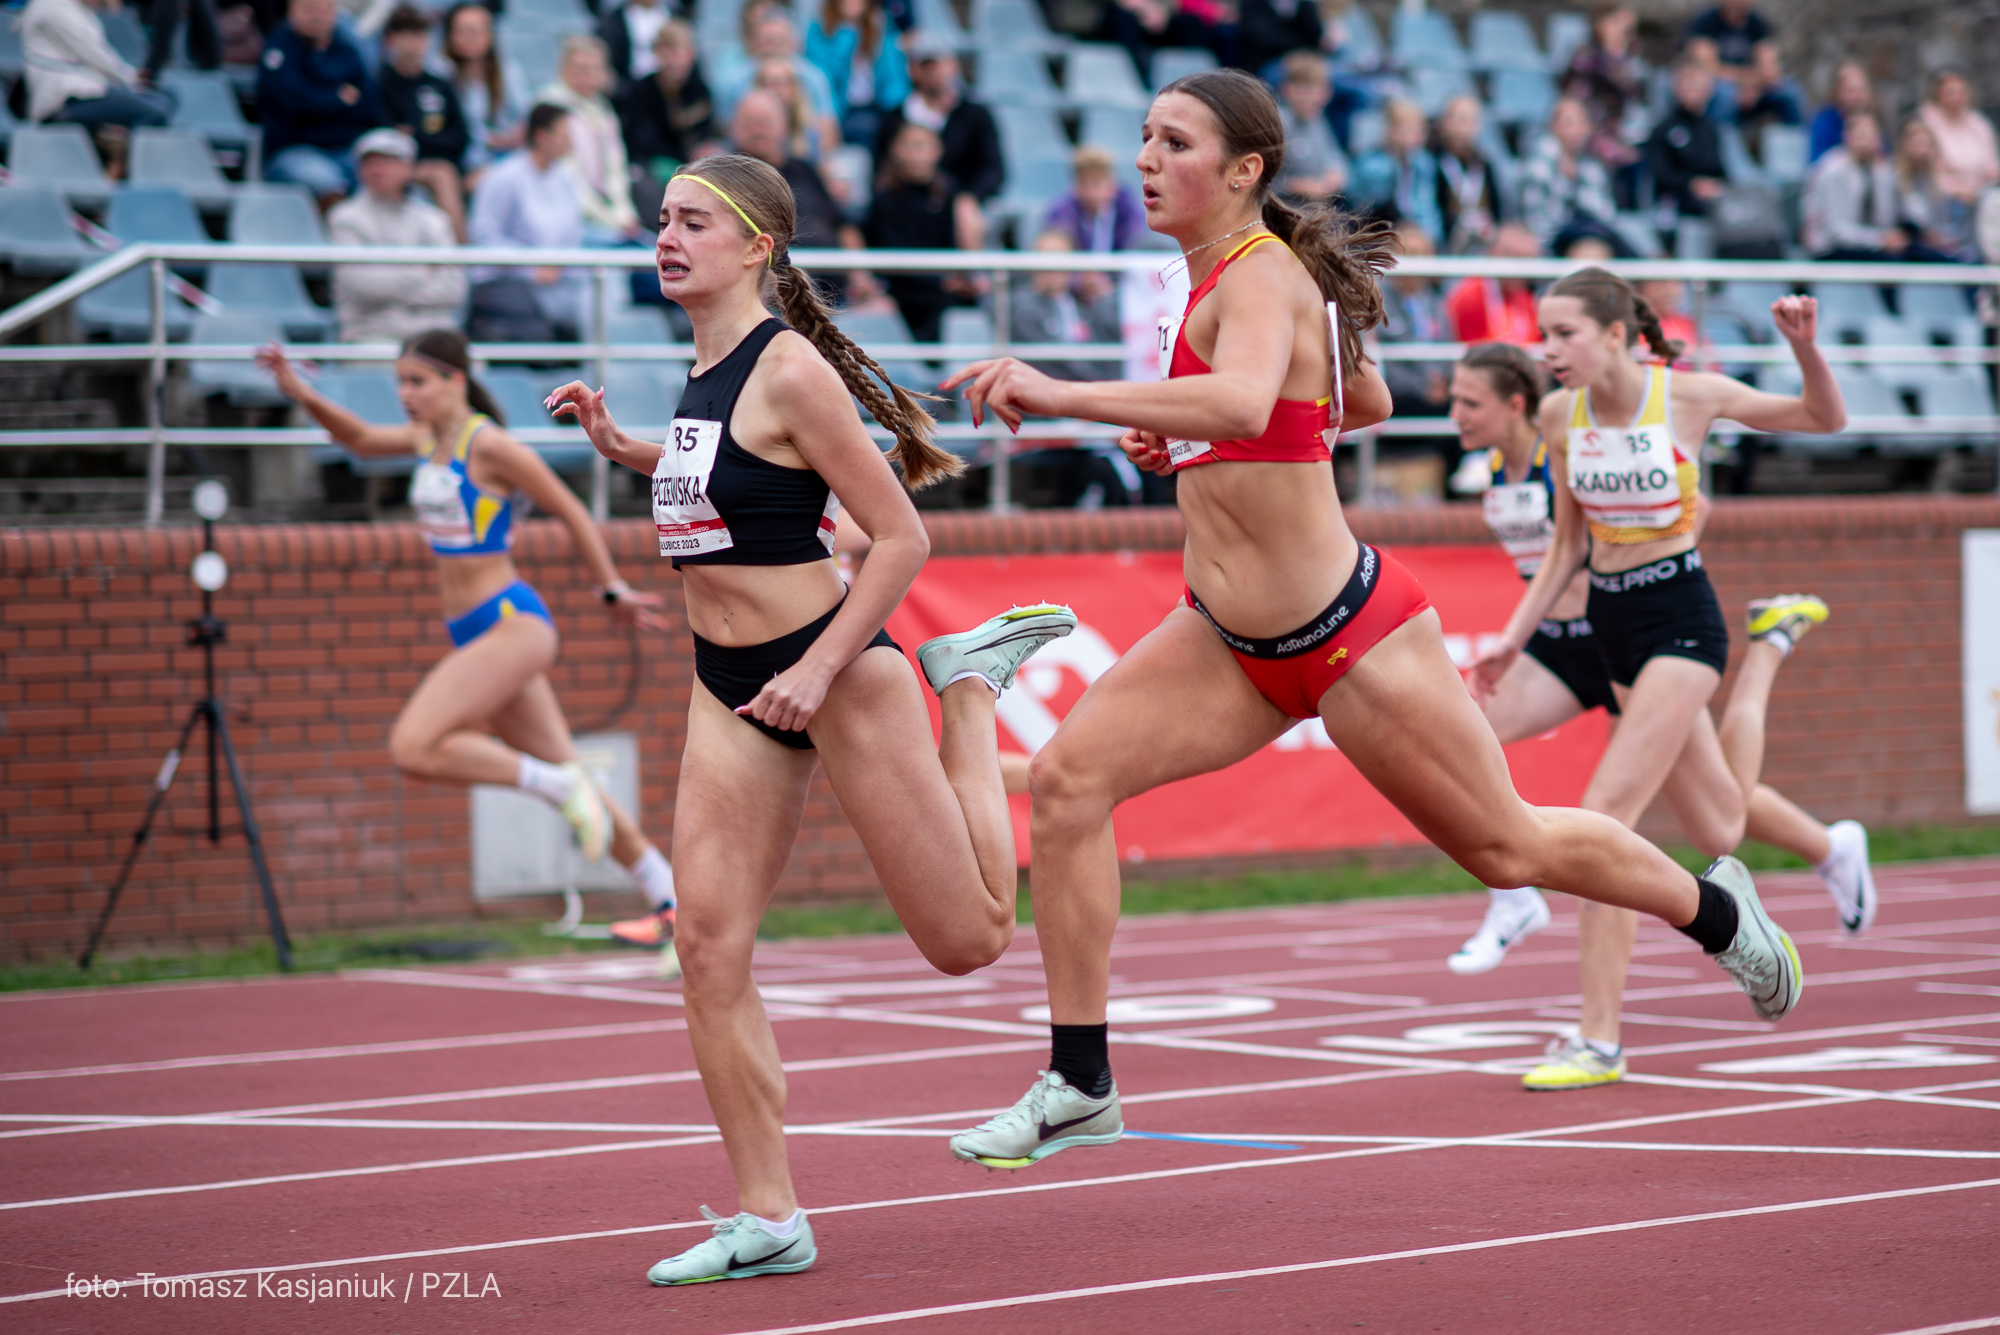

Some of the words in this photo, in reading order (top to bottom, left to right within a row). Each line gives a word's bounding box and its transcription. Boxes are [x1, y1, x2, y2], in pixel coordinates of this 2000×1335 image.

[1625, 432, 1651, 454] 35
[1574, 468, 1668, 493] KADYŁO
[681, 538, 700, 549] 2023
[1623, 559, 1679, 591] PRO
